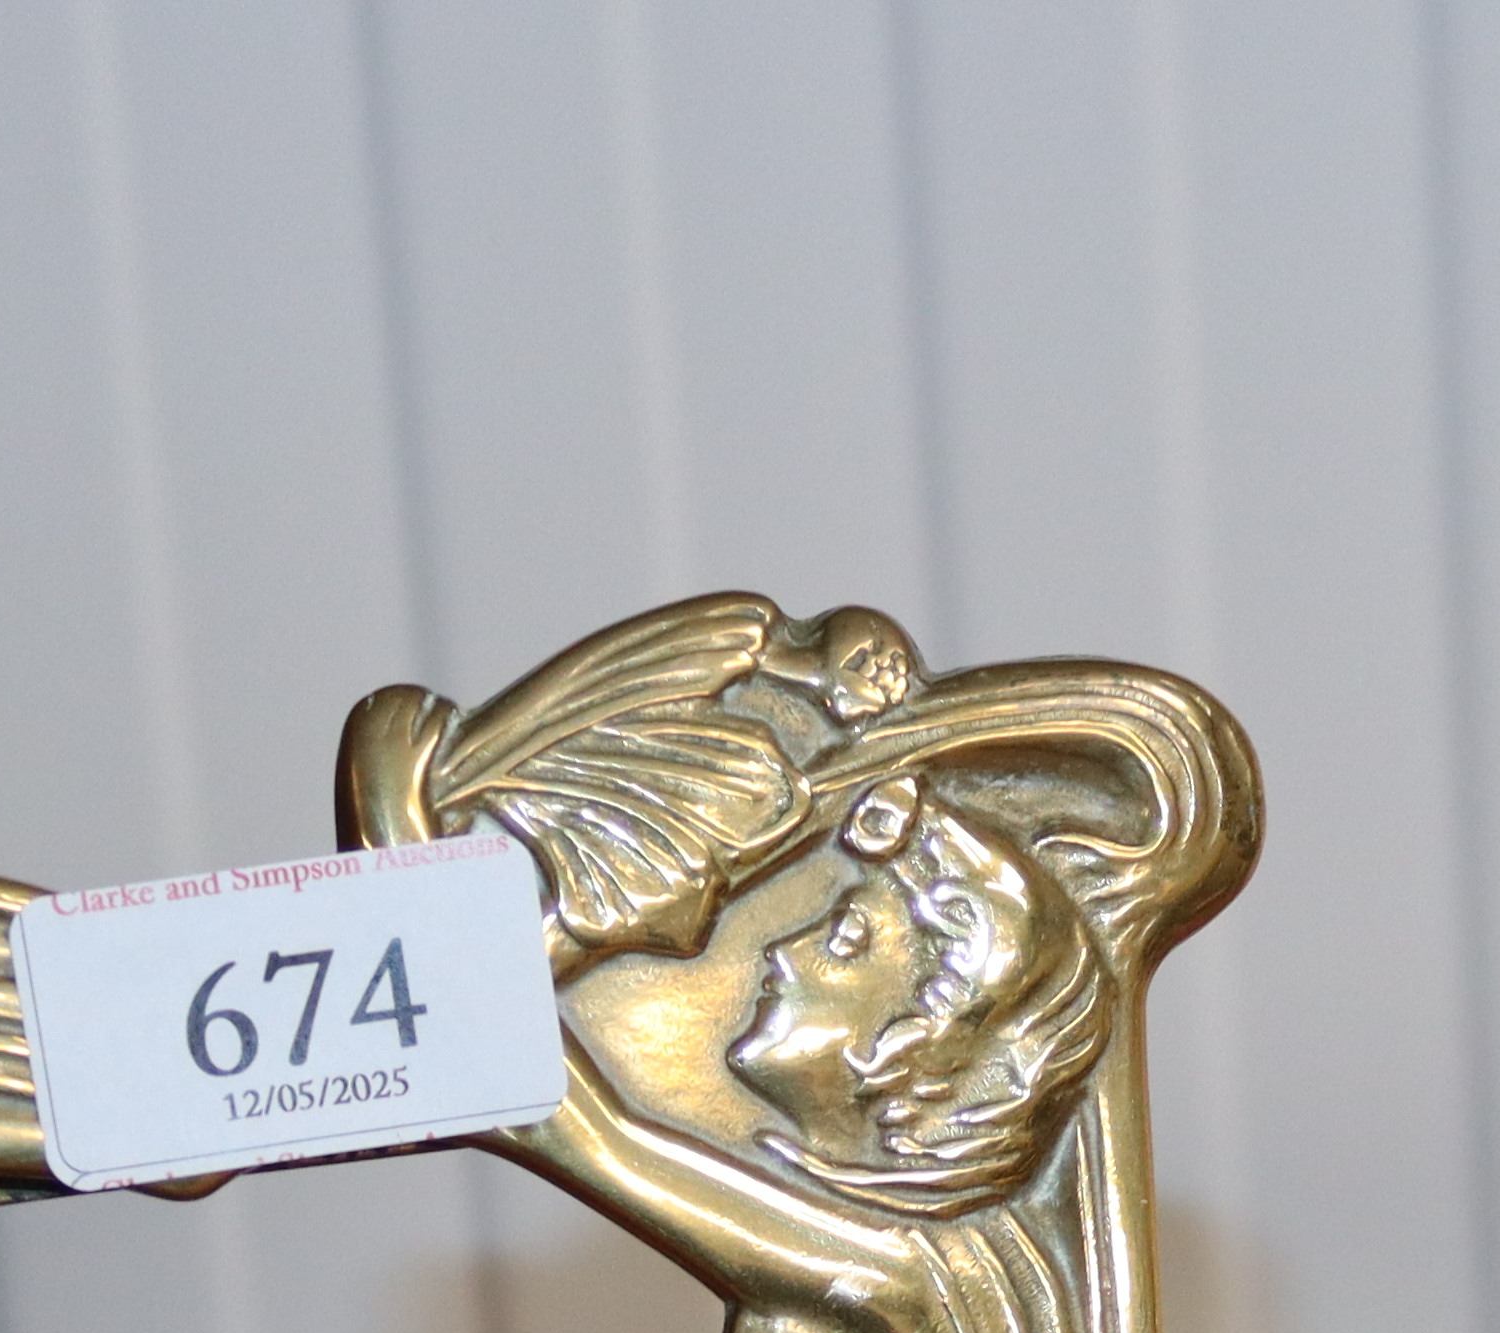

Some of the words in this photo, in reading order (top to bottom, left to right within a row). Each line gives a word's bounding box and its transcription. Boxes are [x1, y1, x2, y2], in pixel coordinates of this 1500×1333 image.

[51, 885, 155, 916] Clarke
[165, 872, 221, 901] and
[231, 856, 361, 893] Simpson
[186, 937, 428, 1077] 674
[223, 1066, 411, 1121] 12/05/2025
